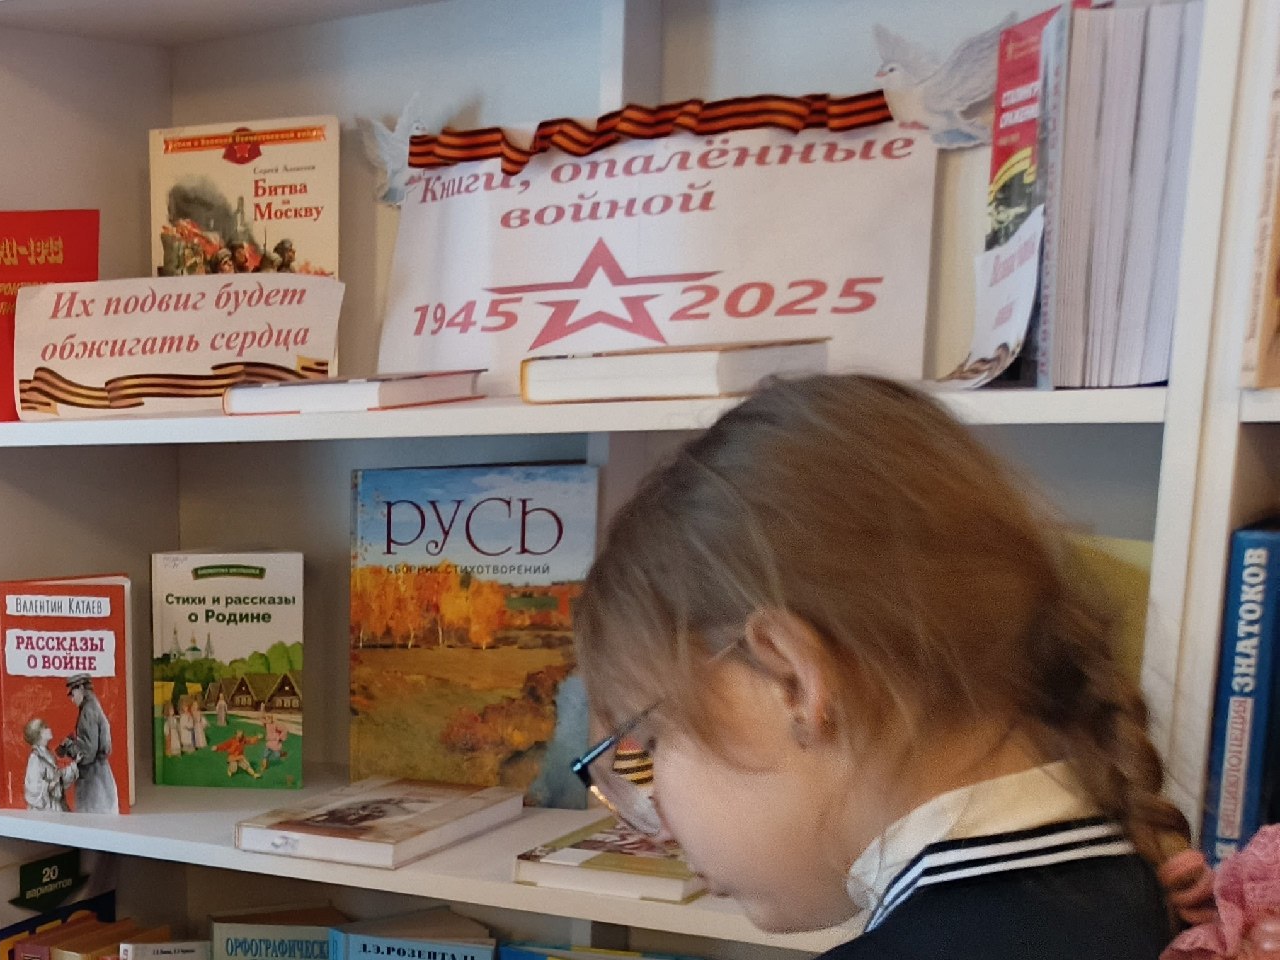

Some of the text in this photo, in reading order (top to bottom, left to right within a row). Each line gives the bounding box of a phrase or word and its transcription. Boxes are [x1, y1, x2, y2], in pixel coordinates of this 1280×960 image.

[551, 137, 917, 184] опалённые
[253, 178, 308, 198] Битва
[253, 202, 324, 222] Москву
[500, 181, 716, 230] войной
[48, 290, 96, 320] Их
[104, 285, 206, 318] подвиг
[214, 282, 307, 317] будет
[413, 277, 884, 337] 1945 2025
[40, 323, 309, 362] обжигать сердца
[382, 496, 564, 557] РУСЬ
[386, 562, 551, 575] СБОРНИК СТИХОТВОРЕНИЙ
[165, 593, 296, 608] Стихи и рассказы
[187, 609, 272, 626] о Родине
[1232, 547, 1269, 693] ЗНАТОКОВ
[15, 635, 105, 652] РАССКАЗЫ
[27, 651, 97, 671] О ВОЙНЕ
[41, 864, 60, 882] 20
[25, 877, 73, 900] вариантов
[225, 937, 329, 959] ОРФОГРАФИЧЕСК
